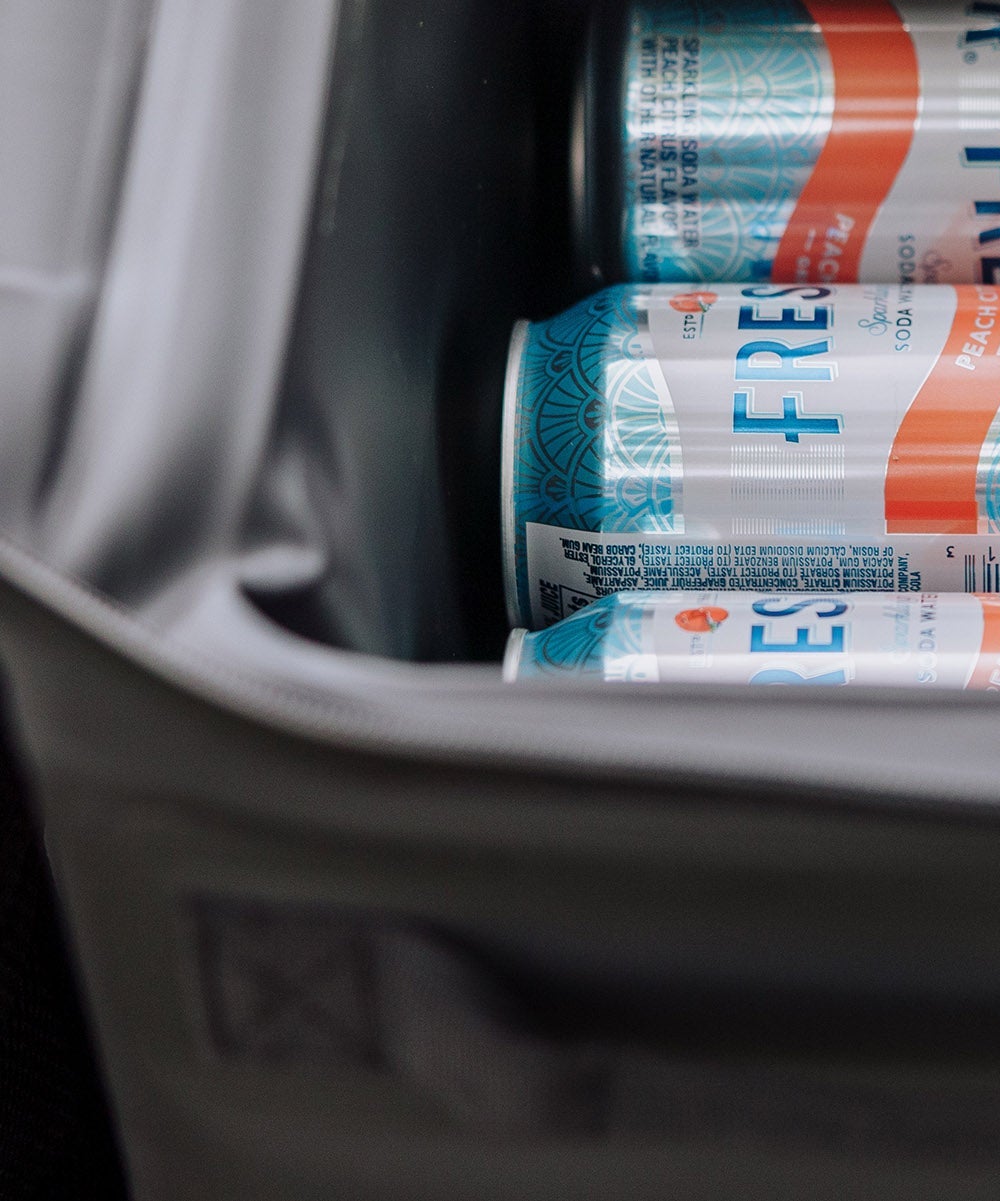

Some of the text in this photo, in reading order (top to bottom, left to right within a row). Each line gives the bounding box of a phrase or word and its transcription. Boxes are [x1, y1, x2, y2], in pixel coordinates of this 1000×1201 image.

[639, 38, 657, 78] WITH
[661, 38, 679, 91] PEACH
[639, 84, 657, 142] OTHER
[682, 140, 699, 187] SODA
[639, 148, 657, 226] NATURAL
[682, 192, 700, 248] WATER
[895, 308, 914, 351] SODA
[955, 304, 998, 370] PEACH
[559, 537, 894, 557] OF ROSIN, CALCIUM DISODIUM EDTA (TO PROTECT TASTE), CAROB BEAN GUM.
[564, 549, 894, 567] ACACIA GUM, POTASSIUM BENZOATE (TO PROTECT TASTE), GLYCEROL ESTER
[946, 545, 955, 558] 3
[583, 572, 894, 588] POTASSIUM CITRATE, CONCENTRATED GRAPEFRUIT JUICE, ASPARTAME,
[587, 563, 894, 578] POTASSIUM SORBATE (TO PROTECT TASTE), ACESULFAME POTASSIUM,
